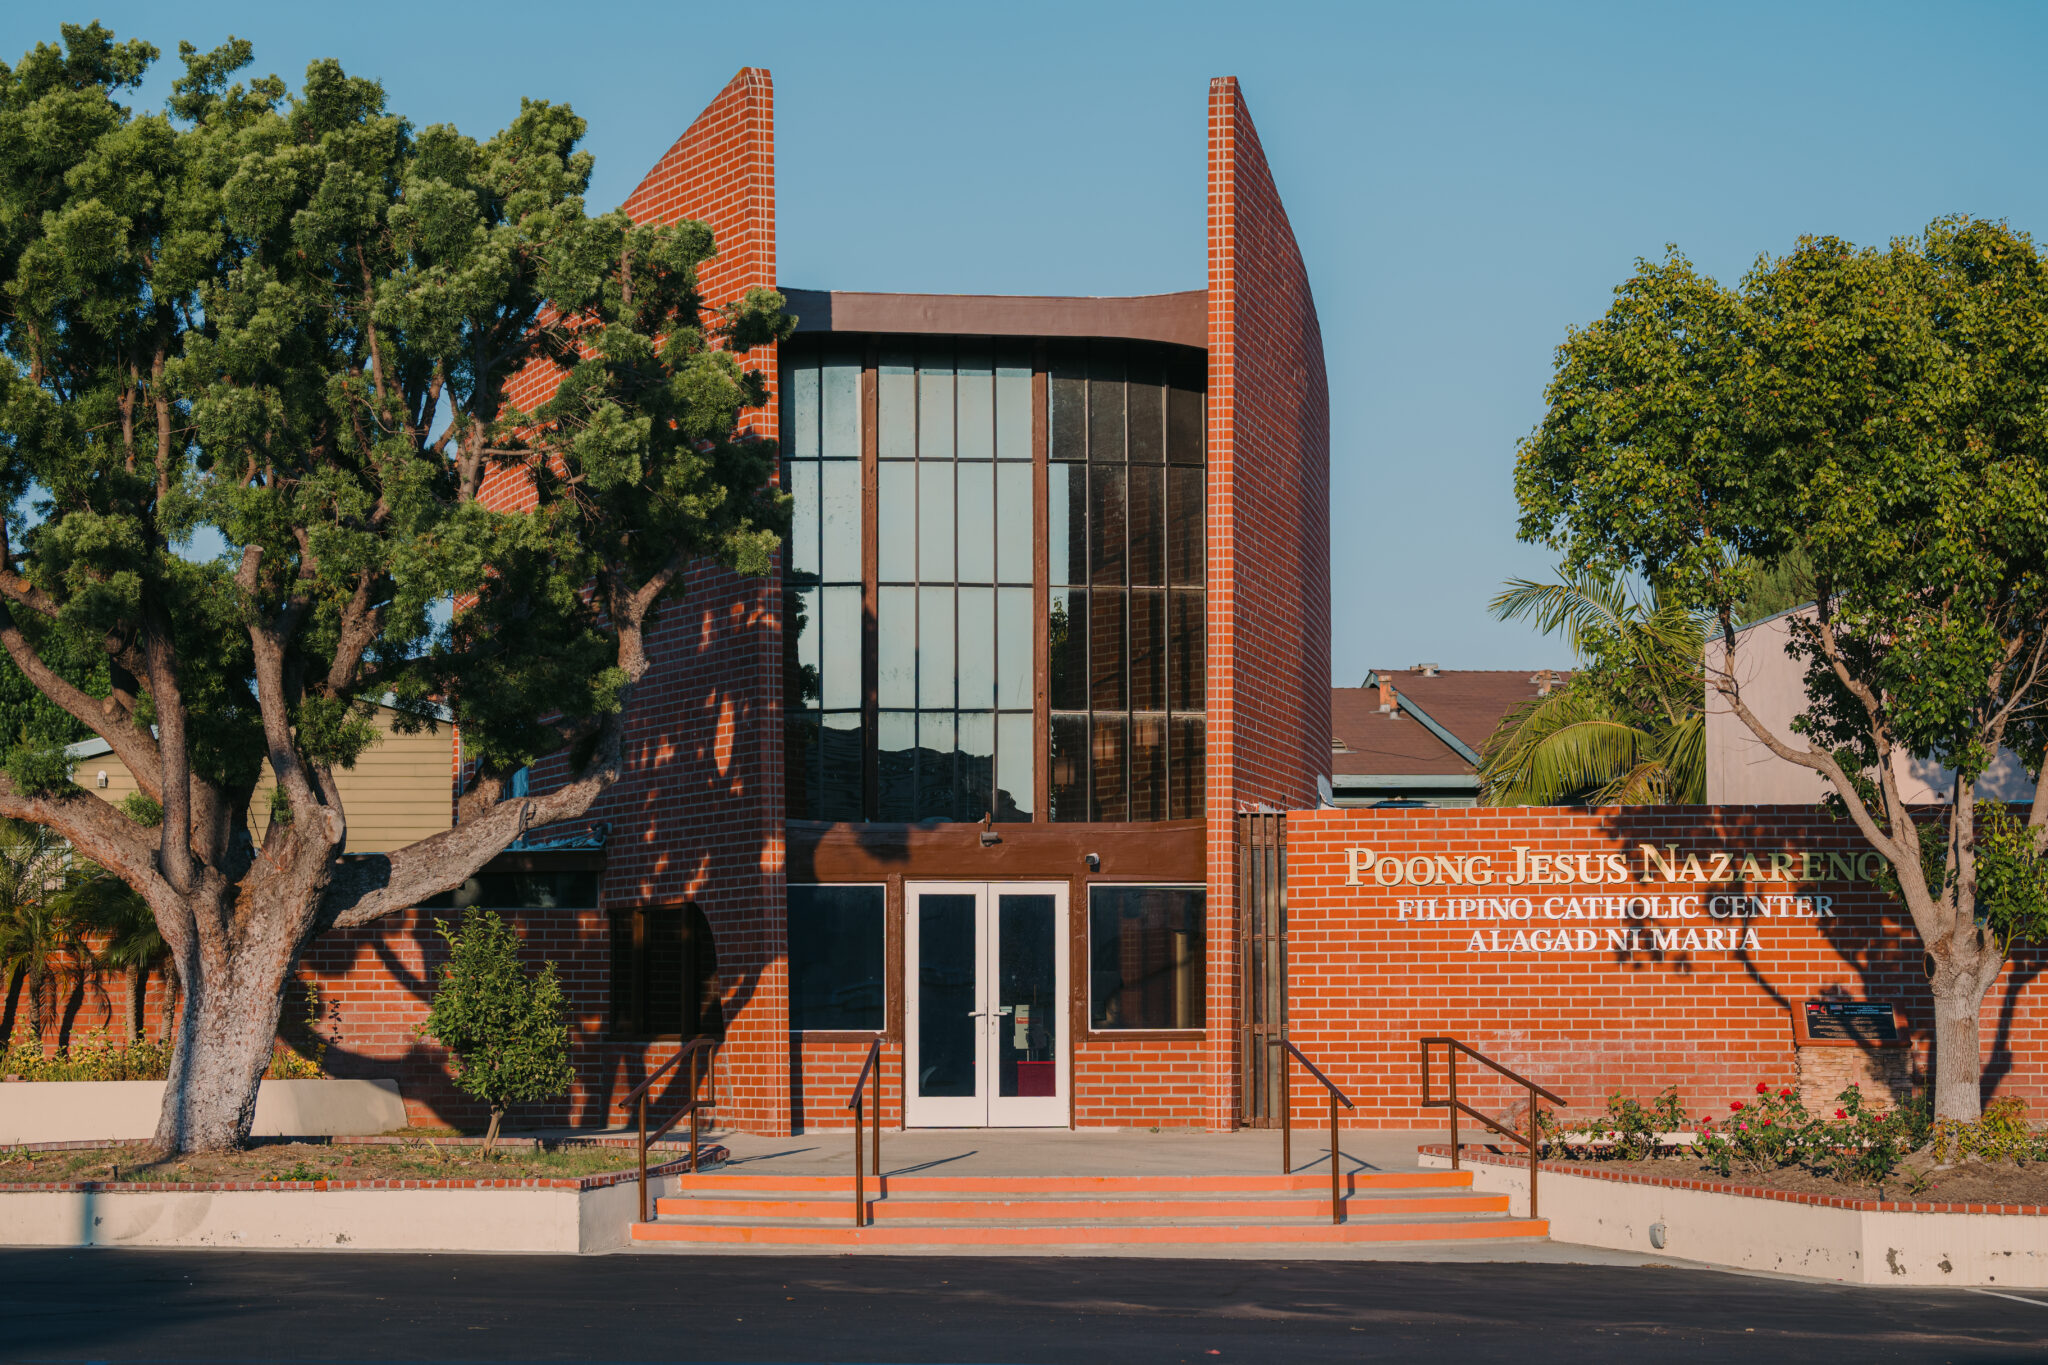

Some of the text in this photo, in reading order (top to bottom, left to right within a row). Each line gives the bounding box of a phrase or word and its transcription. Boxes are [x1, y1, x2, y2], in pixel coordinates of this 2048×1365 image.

[1344, 843, 1889, 886] POONG JESUS NAZARENO
[1396, 895, 1836, 921] FILIPINO CATHOLIC CENTER
[1466, 927, 1763, 953] ALAGAD NI MARIA
